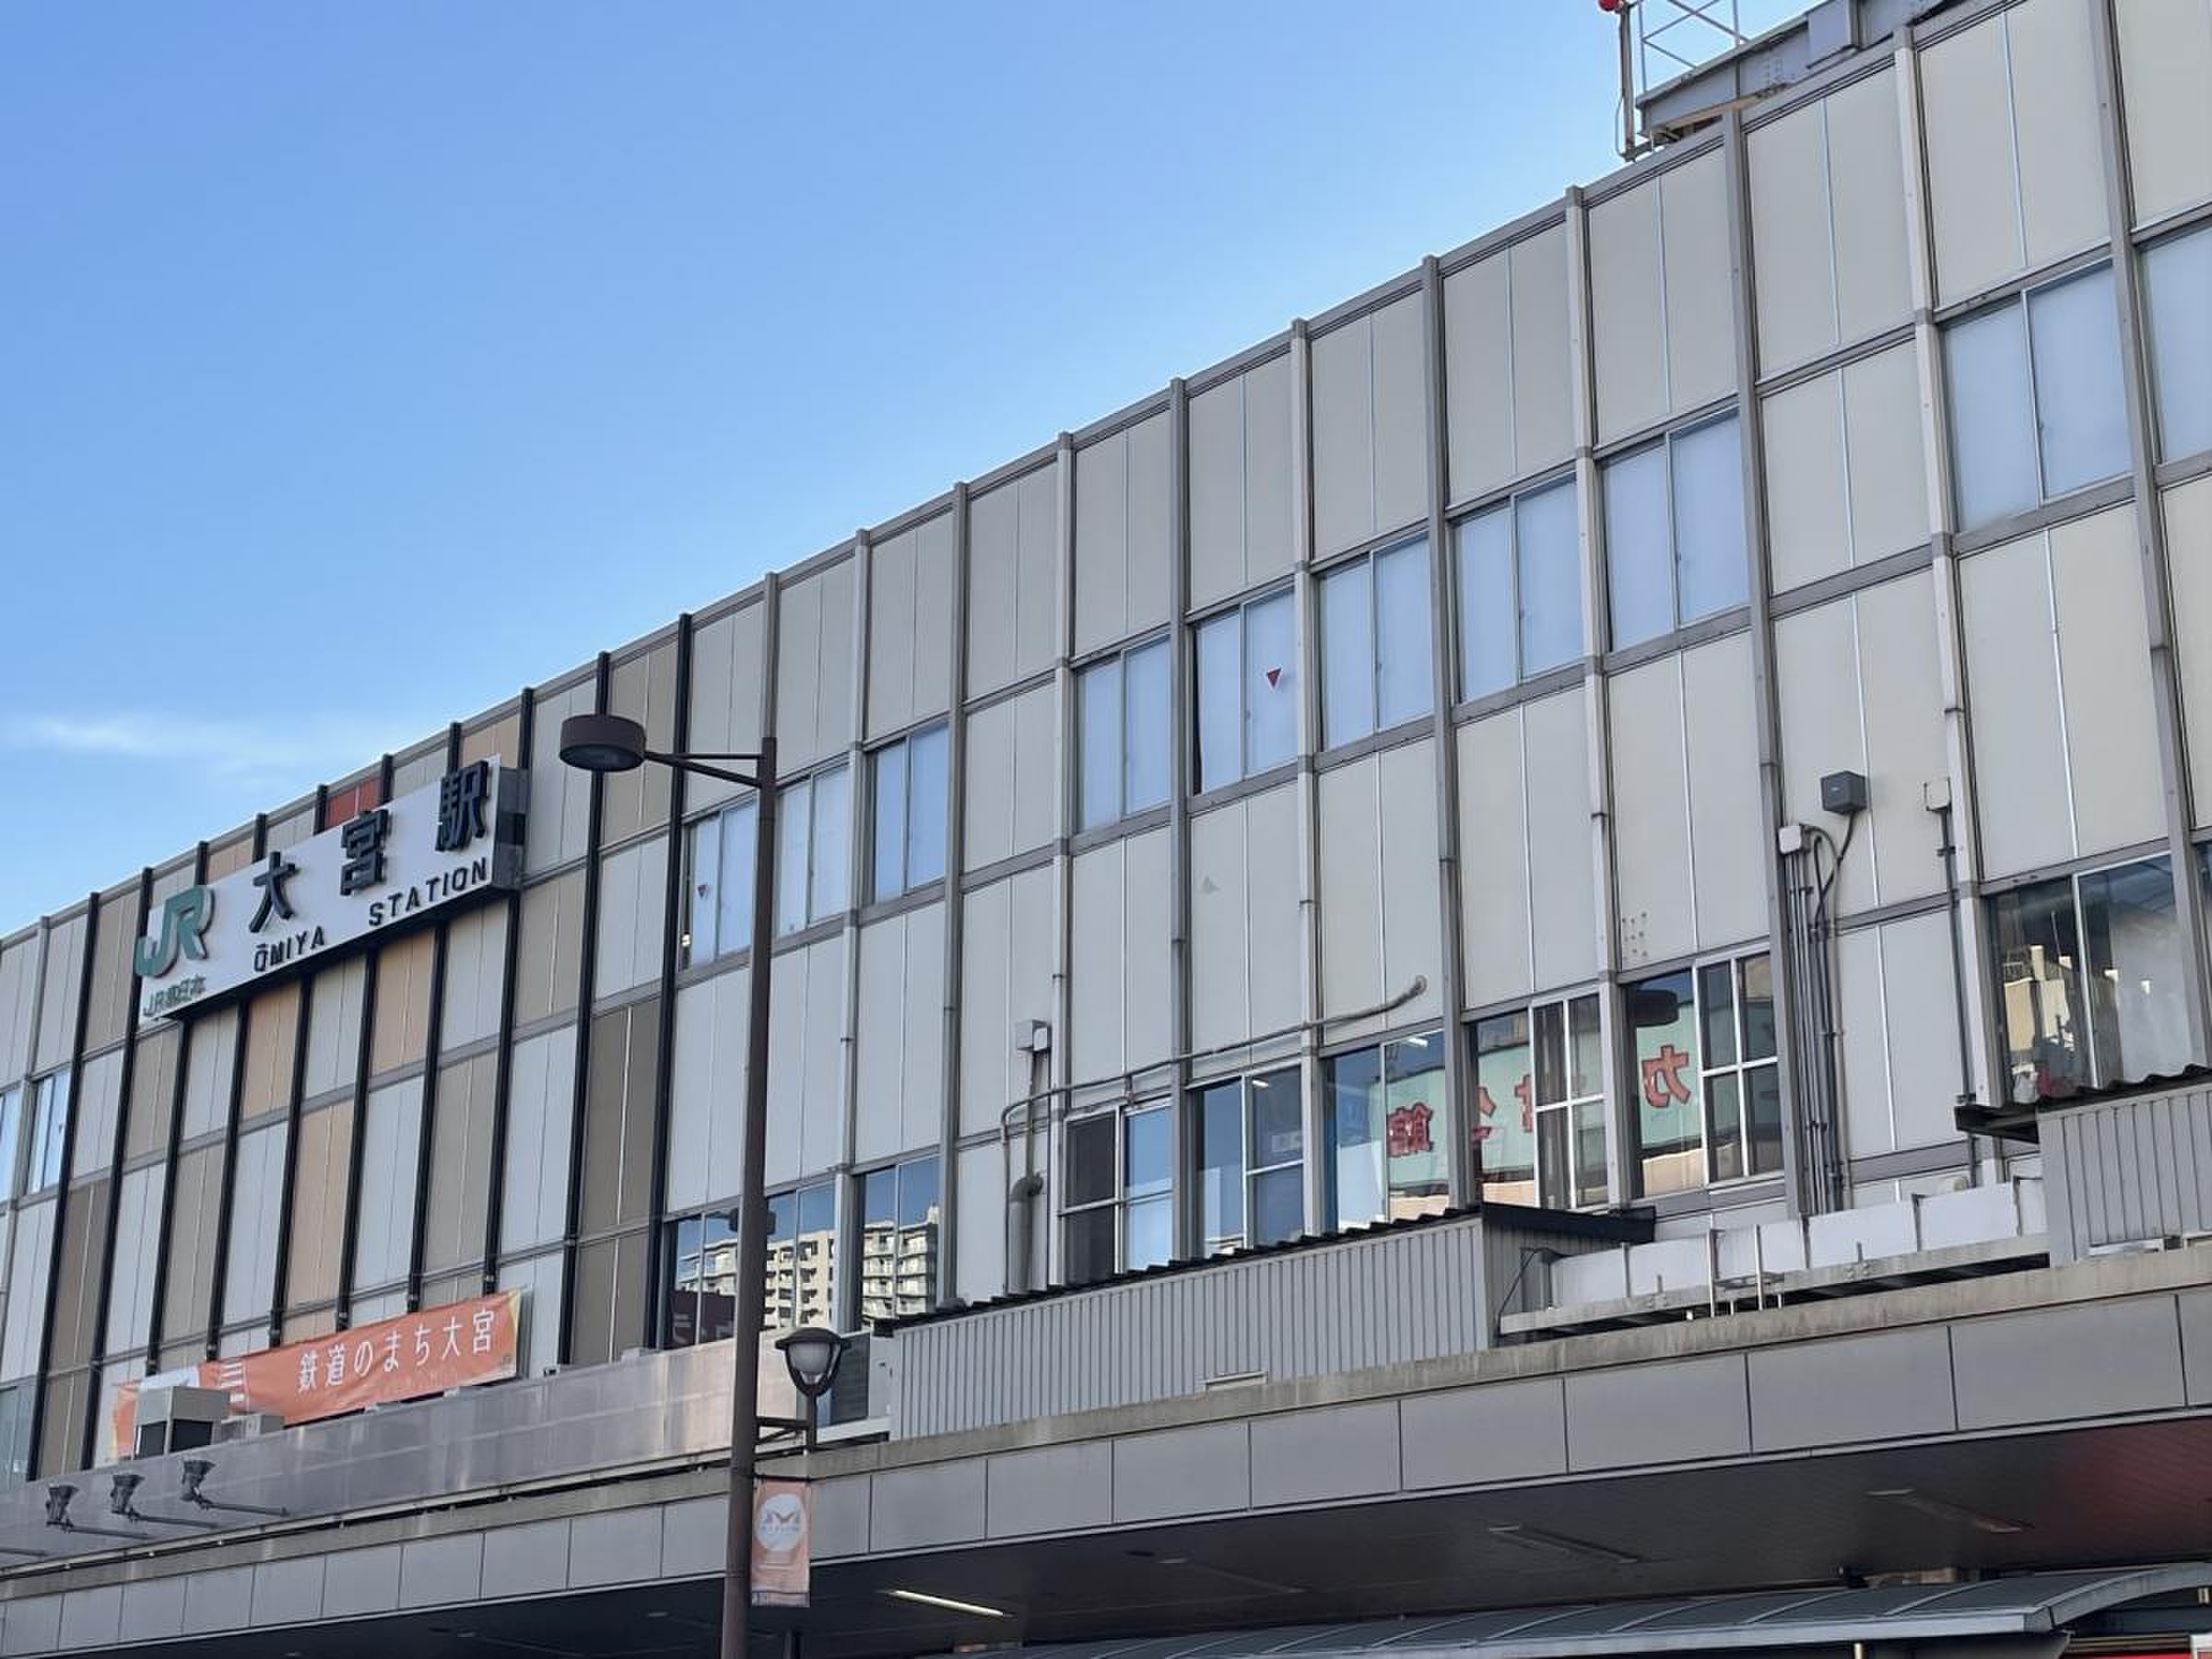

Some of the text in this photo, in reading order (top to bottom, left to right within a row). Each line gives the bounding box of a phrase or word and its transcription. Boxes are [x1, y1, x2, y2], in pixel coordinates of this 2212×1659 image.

[249, 760, 488, 933] 大宮駅
[369, 857, 487, 926] STATION
[134, 884, 216, 978] JR
[297, 1306, 495, 1393] 鉄道のまち大宮
